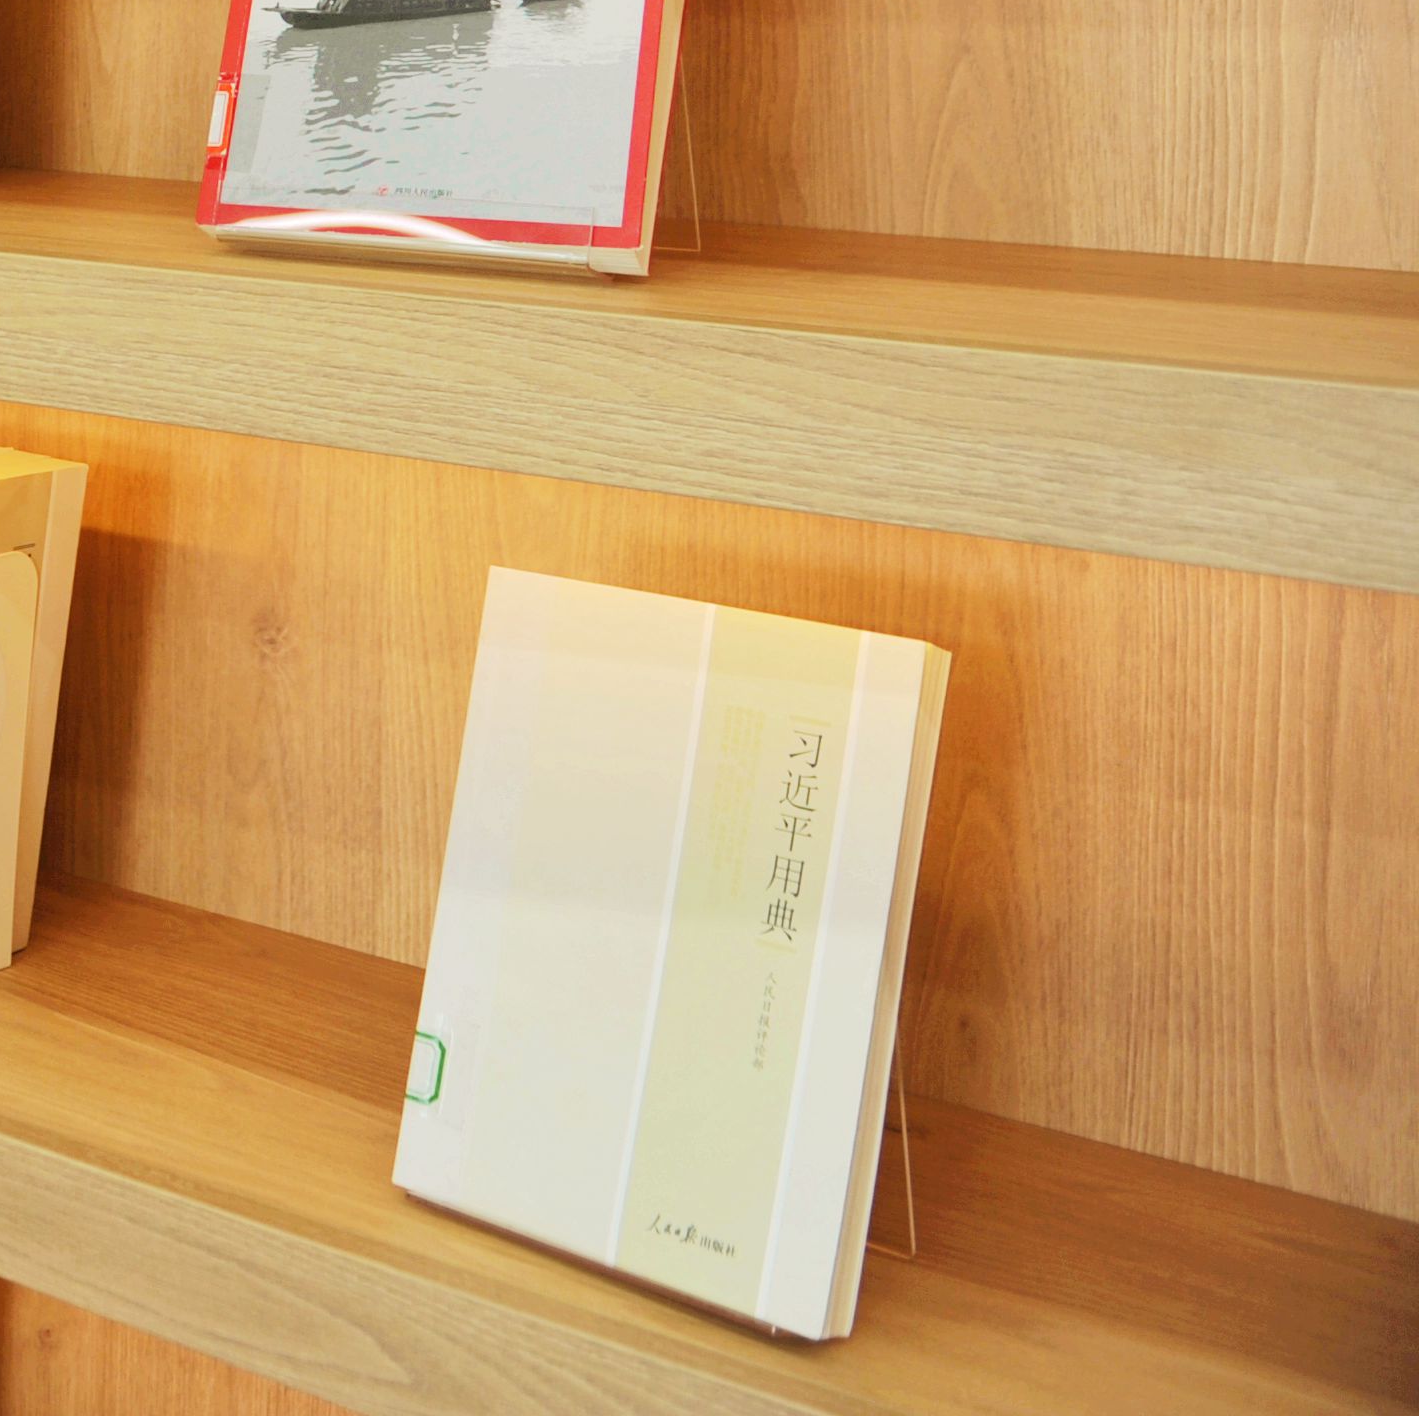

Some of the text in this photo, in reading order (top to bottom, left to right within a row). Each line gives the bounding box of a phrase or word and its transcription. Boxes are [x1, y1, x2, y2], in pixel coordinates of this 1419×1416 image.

[759, 727, 825, 945] 习近平用典
